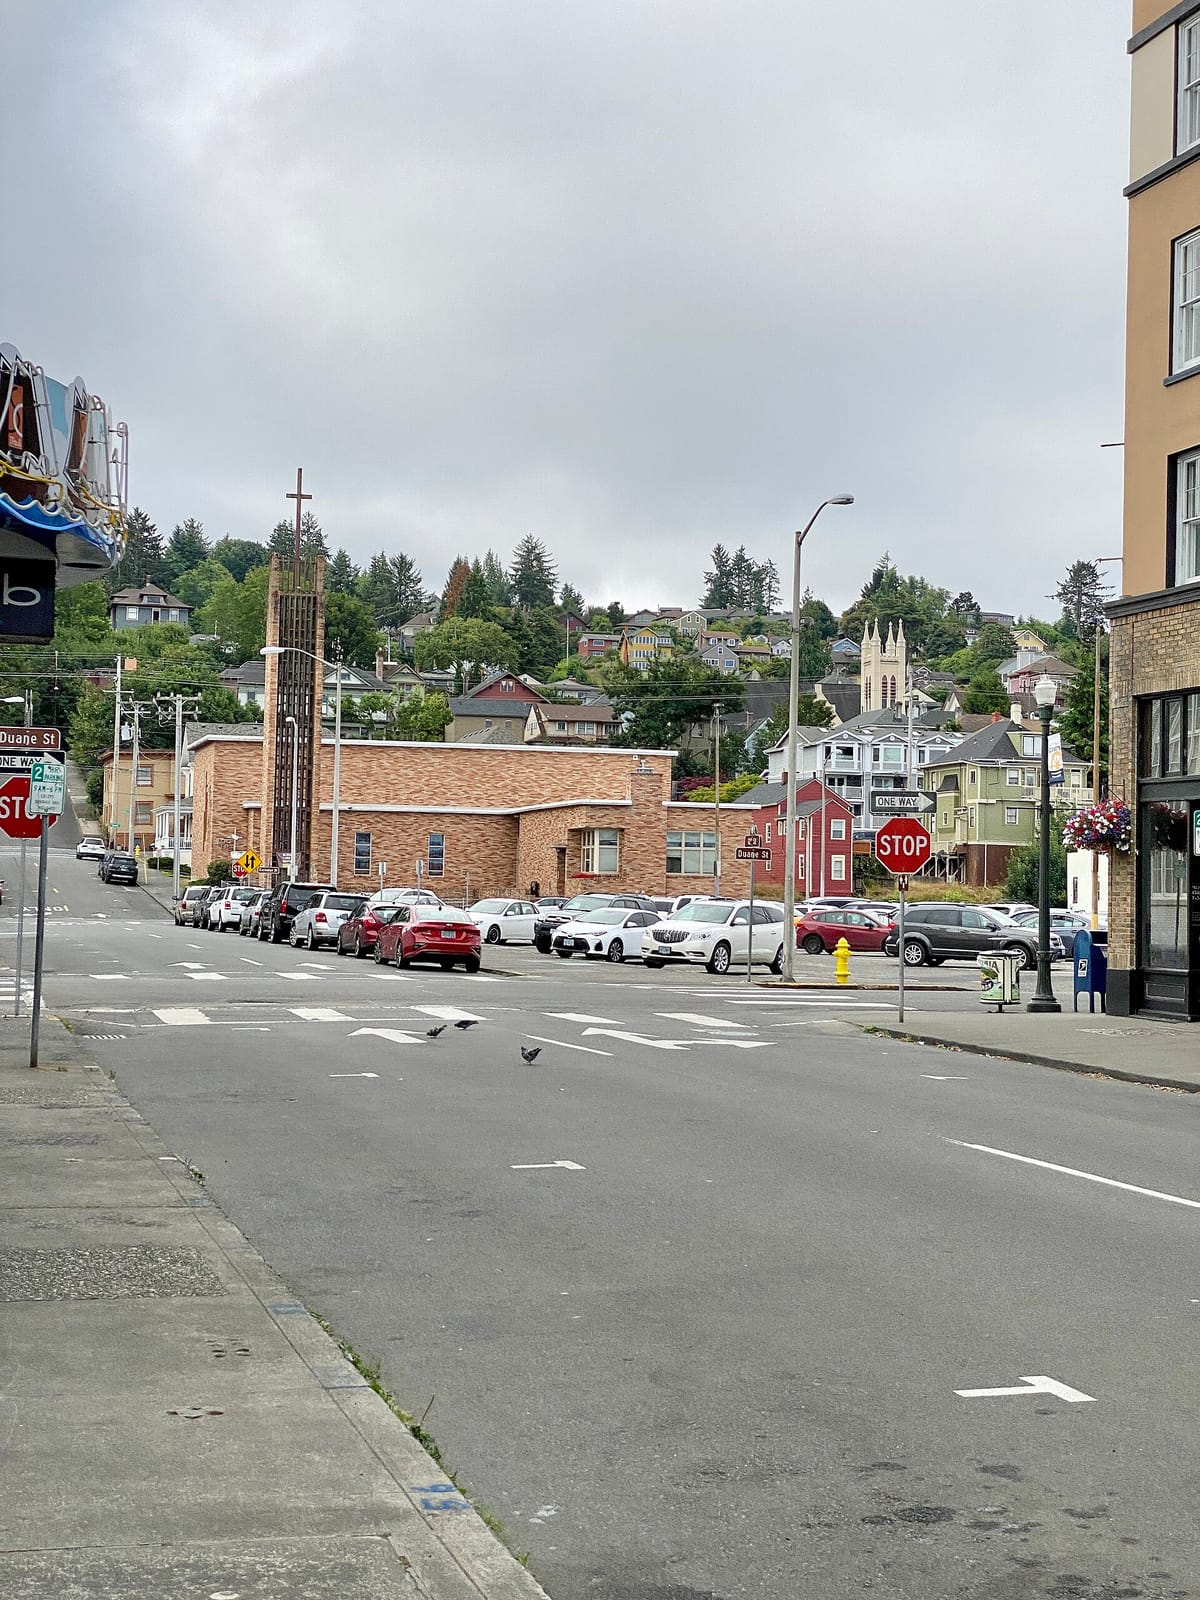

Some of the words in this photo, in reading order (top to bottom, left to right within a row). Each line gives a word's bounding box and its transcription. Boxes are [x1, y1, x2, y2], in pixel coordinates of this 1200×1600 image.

[0, 731, 37, 745] Duane
[43, 733, 55, 745] St
[34, 766, 42, 779] 2
[0, 796, 42, 820] STO
[877, 797, 896, 806] ONE
[898, 798, 917, 806] WAY
[879, 835, 928, 856] STOP
[737, 850, 759, 859] Duane
[761, 850, 769, 859] St
